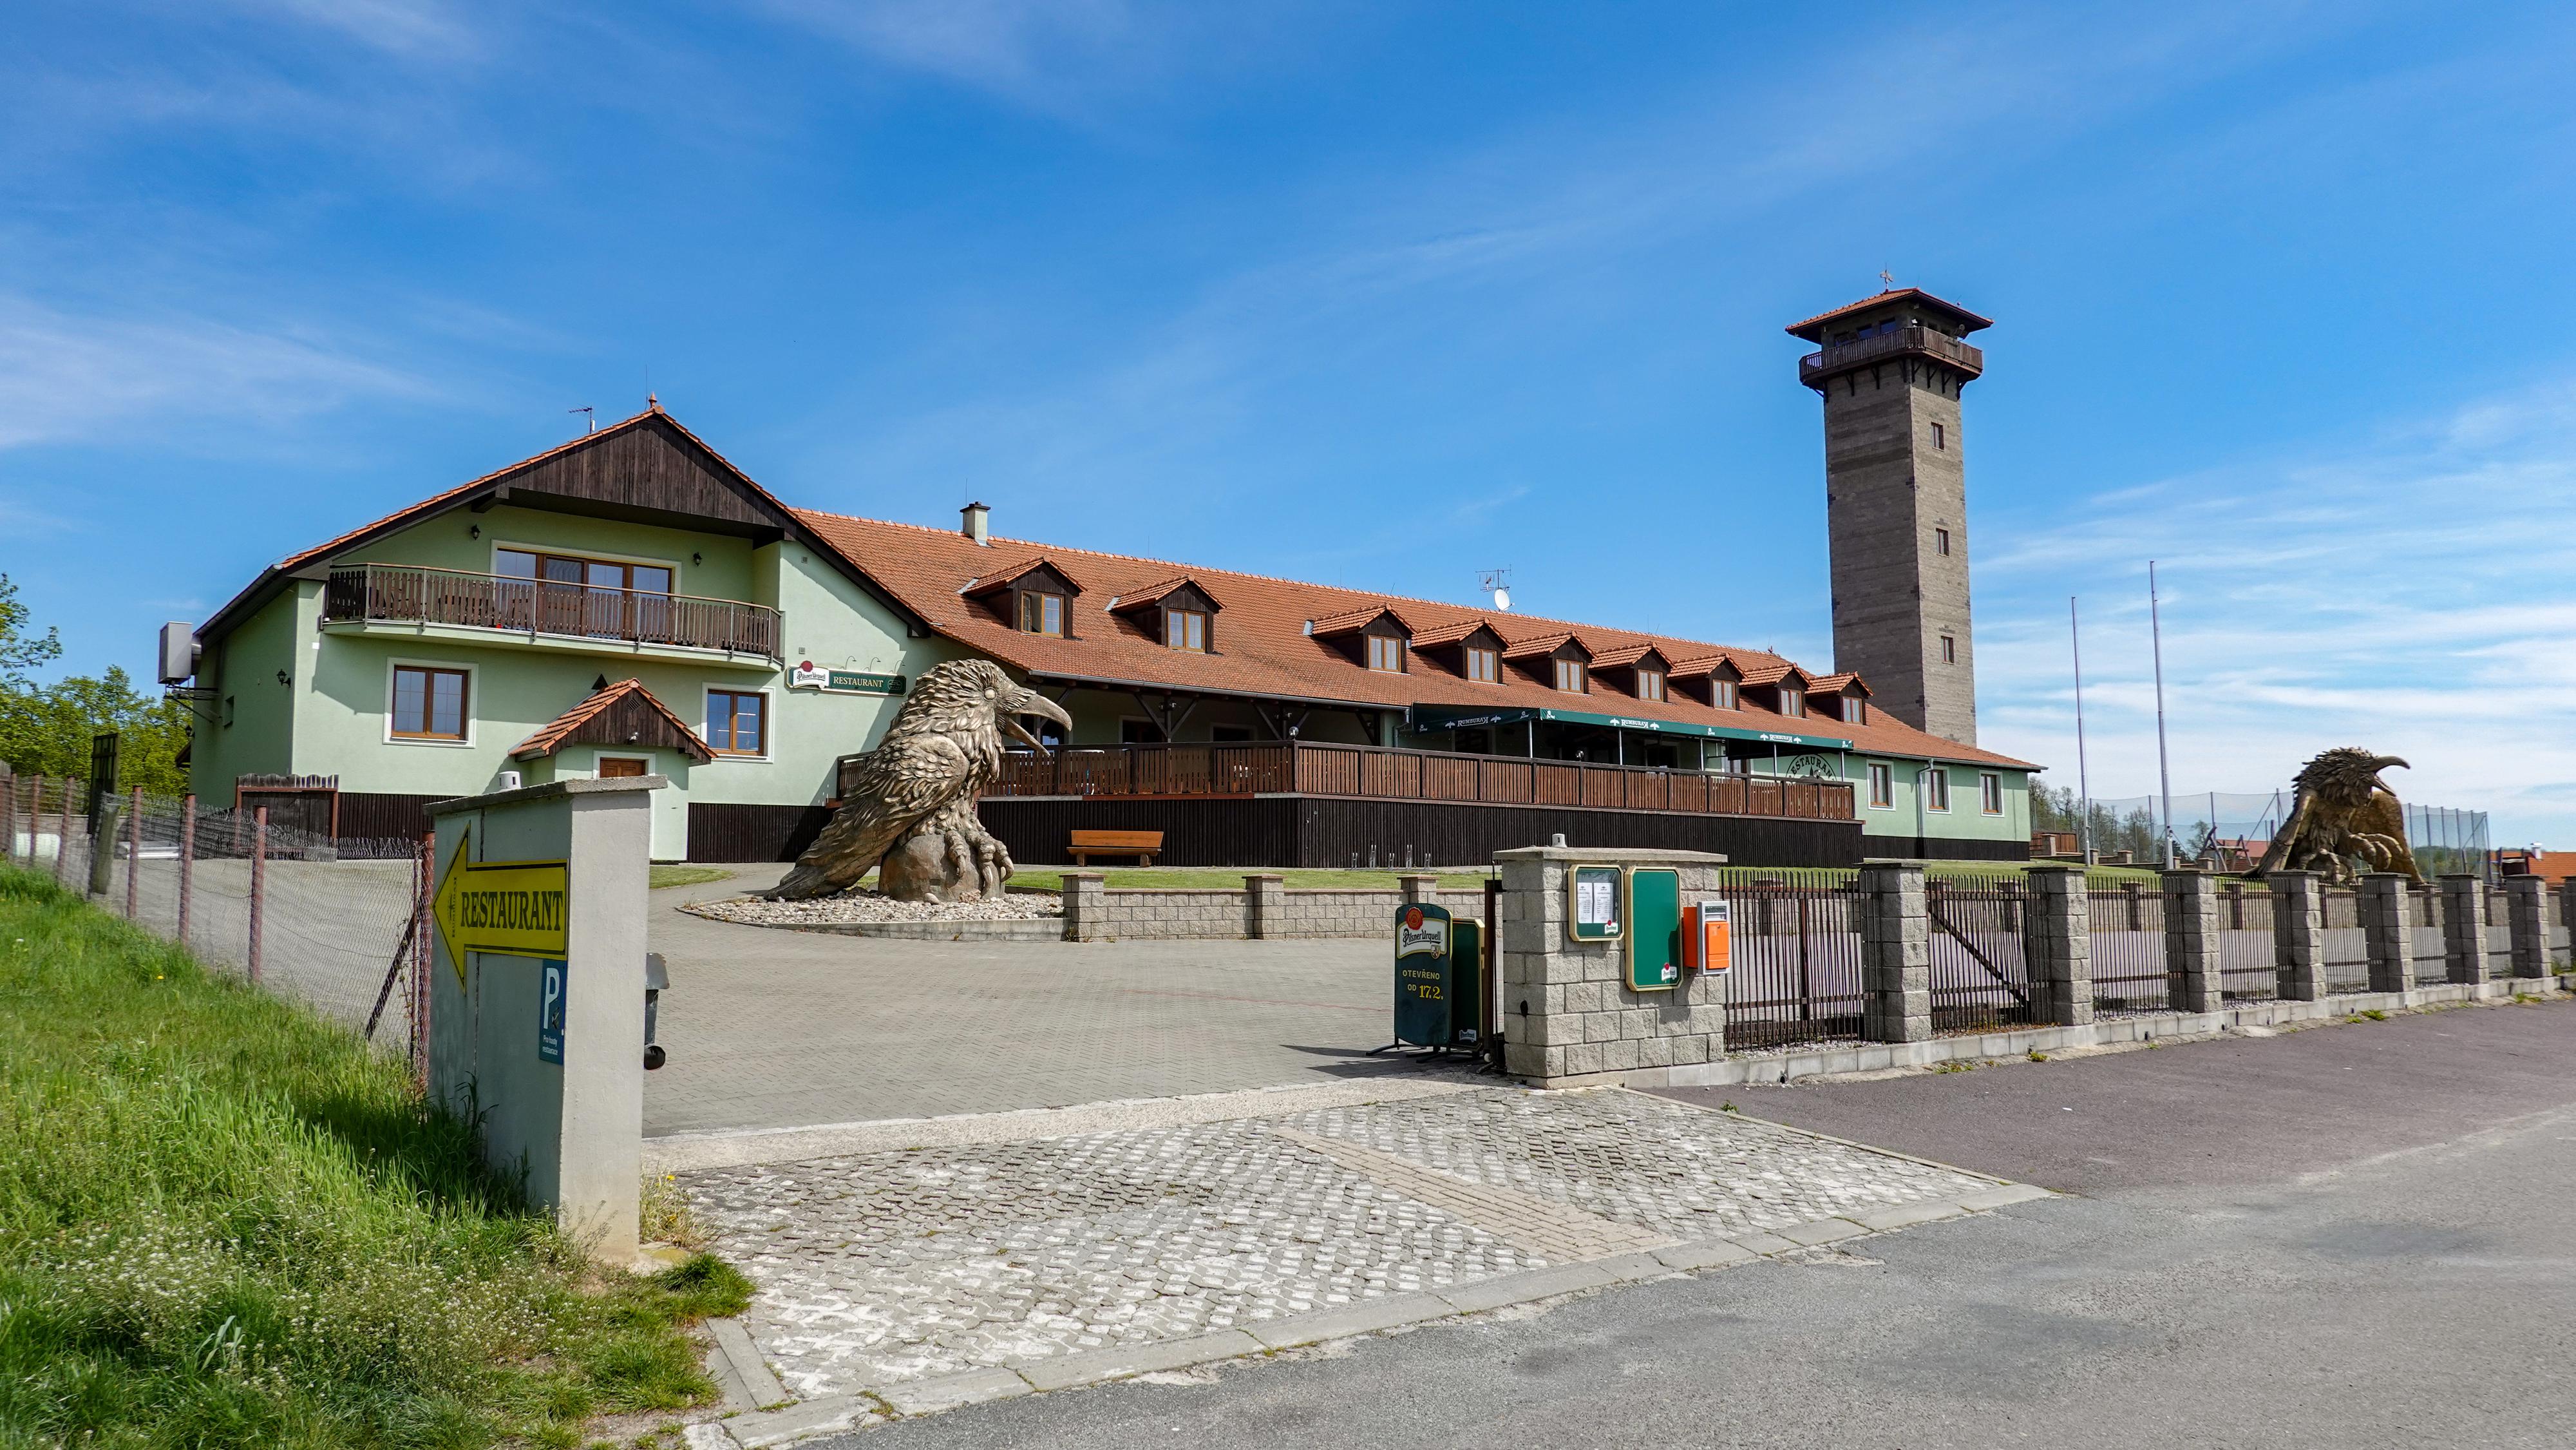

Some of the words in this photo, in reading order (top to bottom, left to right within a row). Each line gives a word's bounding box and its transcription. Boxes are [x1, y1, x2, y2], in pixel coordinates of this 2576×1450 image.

[833, 676, 884, 687] RESTAURANT
[1457, 716, 1489, 727] RUMBURAK
[1621, 719, 1649, 729] RUMBURAK
[1788, 756, 1835, 781] ESTAURAN
[460, 891, 563, 931] RESTAURANT
[1403, 928, 1423, 947] Pilsner
[1421, 929, 1441, 944] Urquell
[1403, 969, 1440, 980] OTEVŘENO
[544, 968, 560, 1029] P
